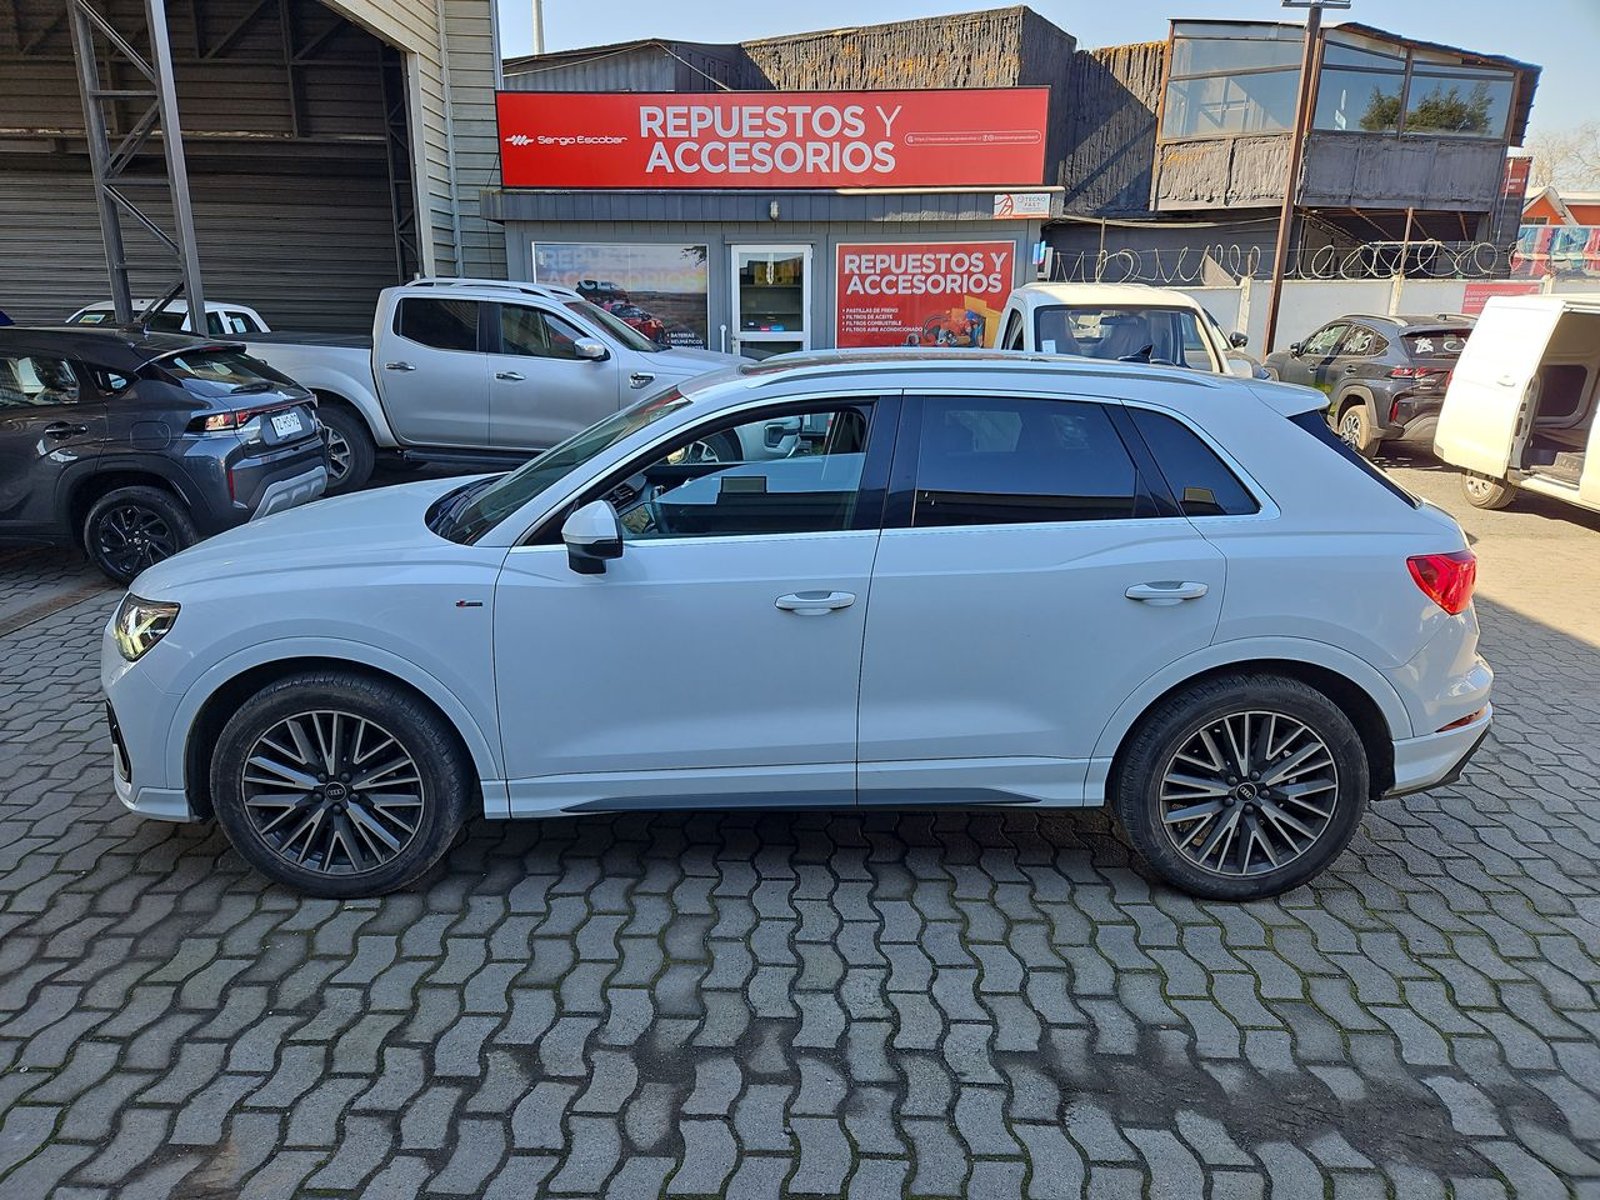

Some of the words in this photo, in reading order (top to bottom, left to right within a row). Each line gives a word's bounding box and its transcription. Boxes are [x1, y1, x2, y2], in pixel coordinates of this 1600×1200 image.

[639, 105, 866, 138] REPUESTOS
[875, 105, 902, 137] Y
[577, 135, 628, 145] Escobar
[645, 141, 896, 174] ACCESORIOS
[844, 252, 985, 274] REPUESTOS
[990, 252, 1008, 272] Y
[846, 273, 1003, 295] ACCESORIOS
